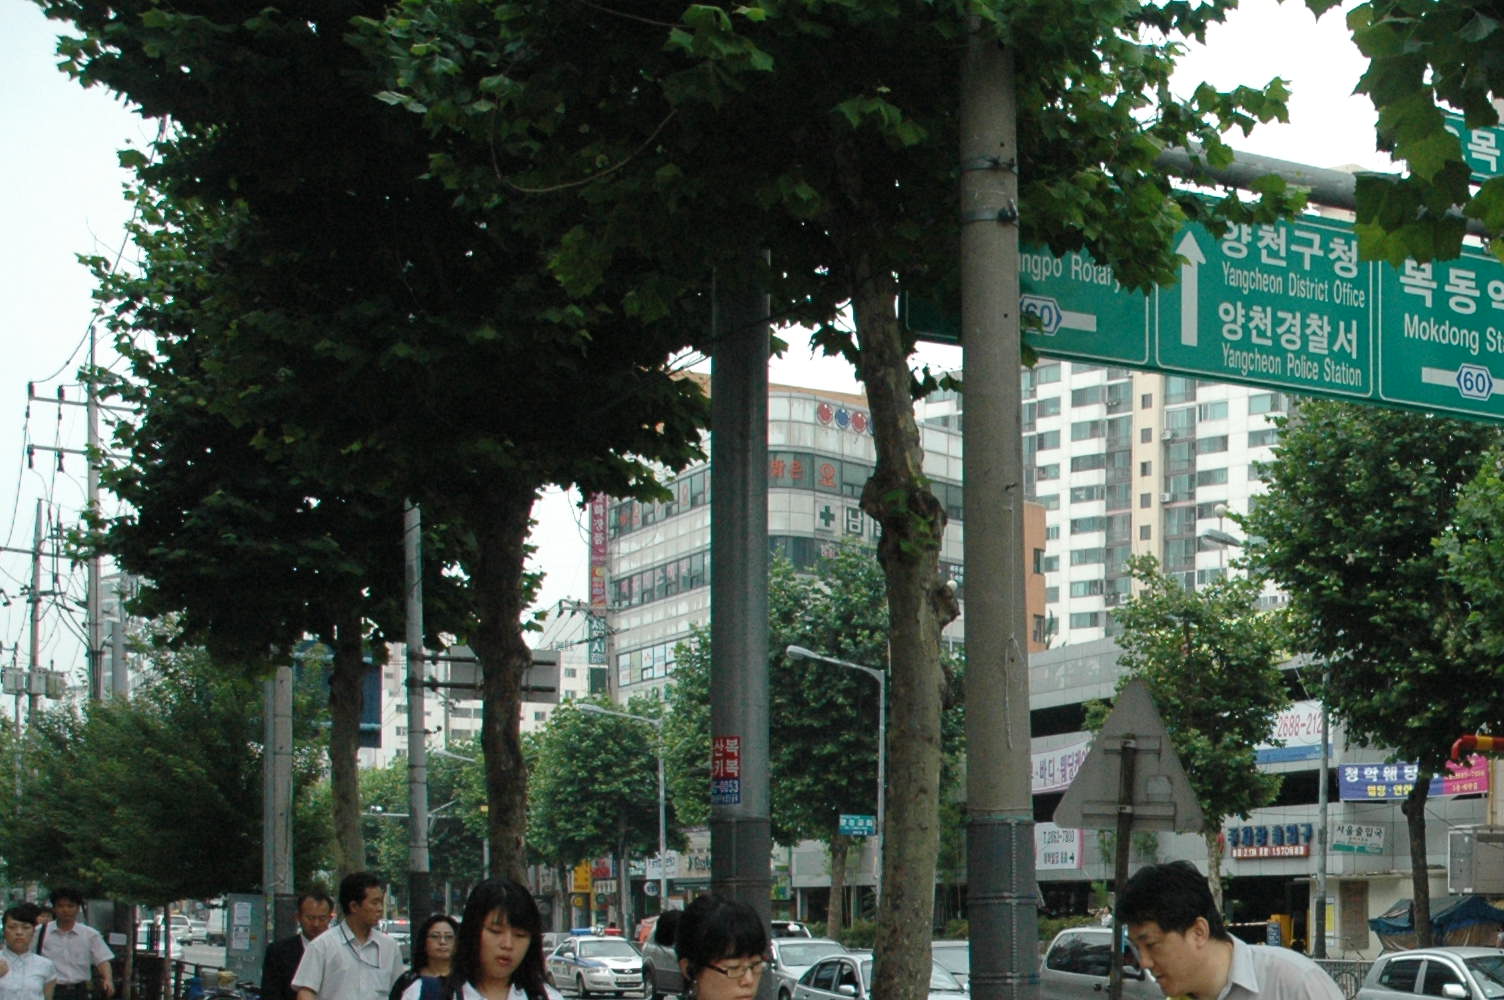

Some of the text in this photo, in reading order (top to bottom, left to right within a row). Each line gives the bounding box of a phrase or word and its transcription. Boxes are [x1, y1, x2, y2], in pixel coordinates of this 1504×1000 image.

[1221, 220, 1359, 279] 양천구청
[1222, 261, 1366, 308] Yangcheon District Office
[1218, 301, 1358, 360] 양천경찰서
[1404, 312, 1480, 356] Mokdong
[1221, 342, 1362, 387] Yangcheon Police Station
[1463, 370, 1487, 394] 60
